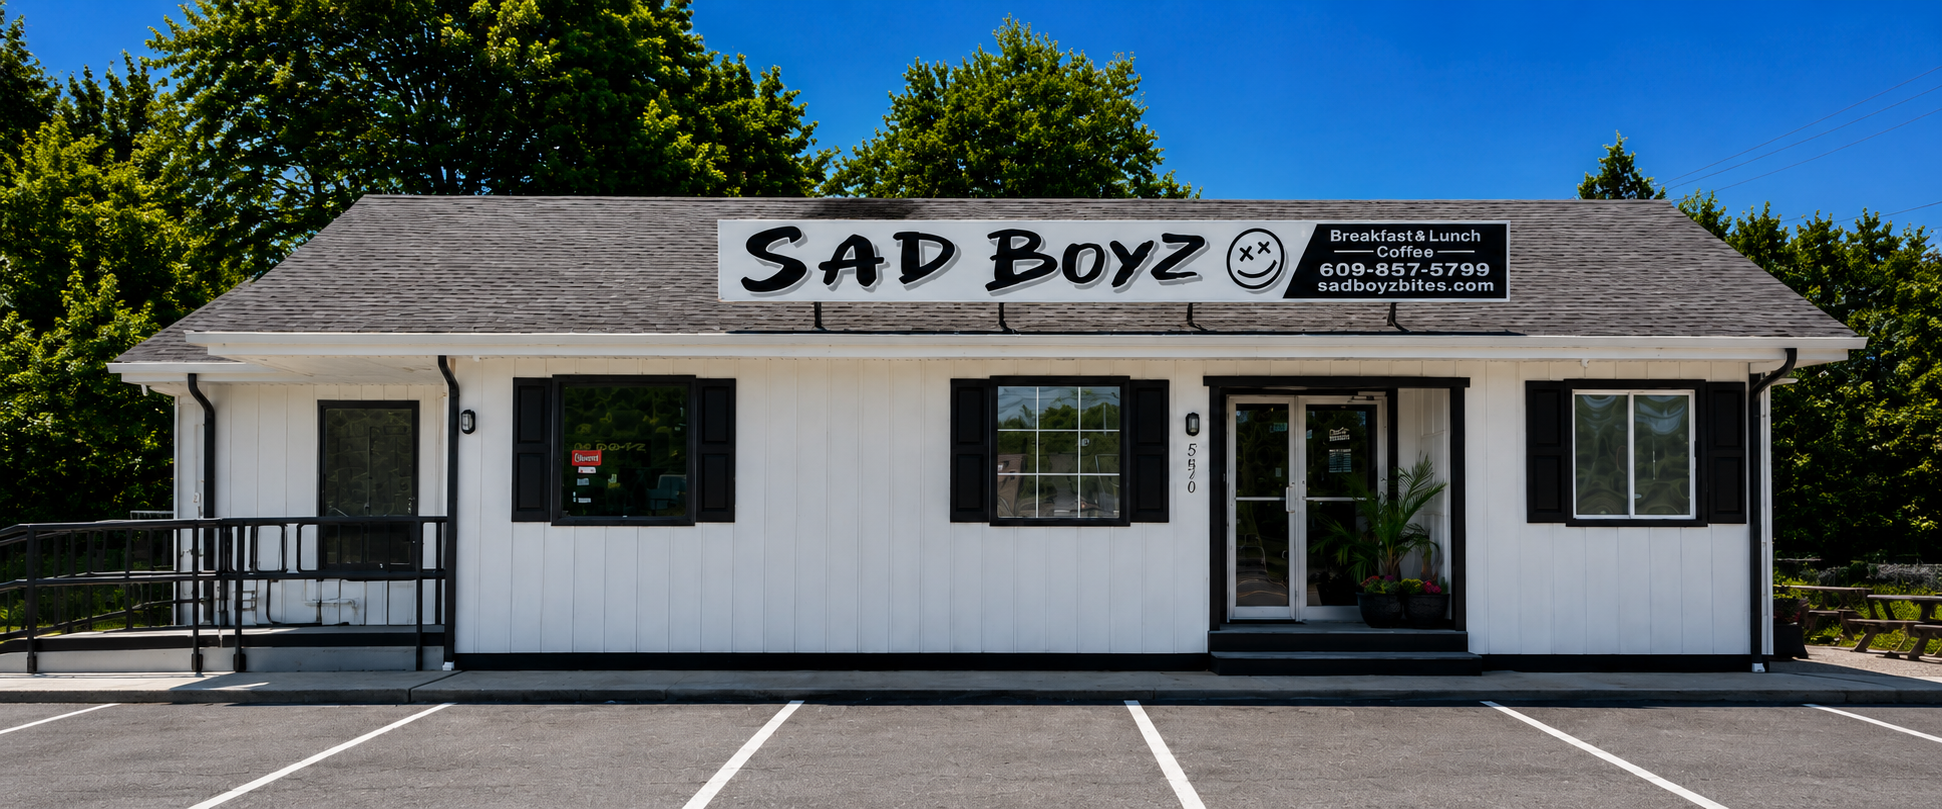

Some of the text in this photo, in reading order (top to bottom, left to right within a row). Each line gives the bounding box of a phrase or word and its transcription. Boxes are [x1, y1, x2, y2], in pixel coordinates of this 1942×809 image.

[1330, 229, 1481, 242] Breakfast & Lunch
[1376, 245, 1434, 258] Coffee
[741, 226, 1207, 293] SAD BOYZ
[1319, 262, 1490, 277] 609-857-5799
[1317, 278, 1494, 294] sadboyzbites.com
